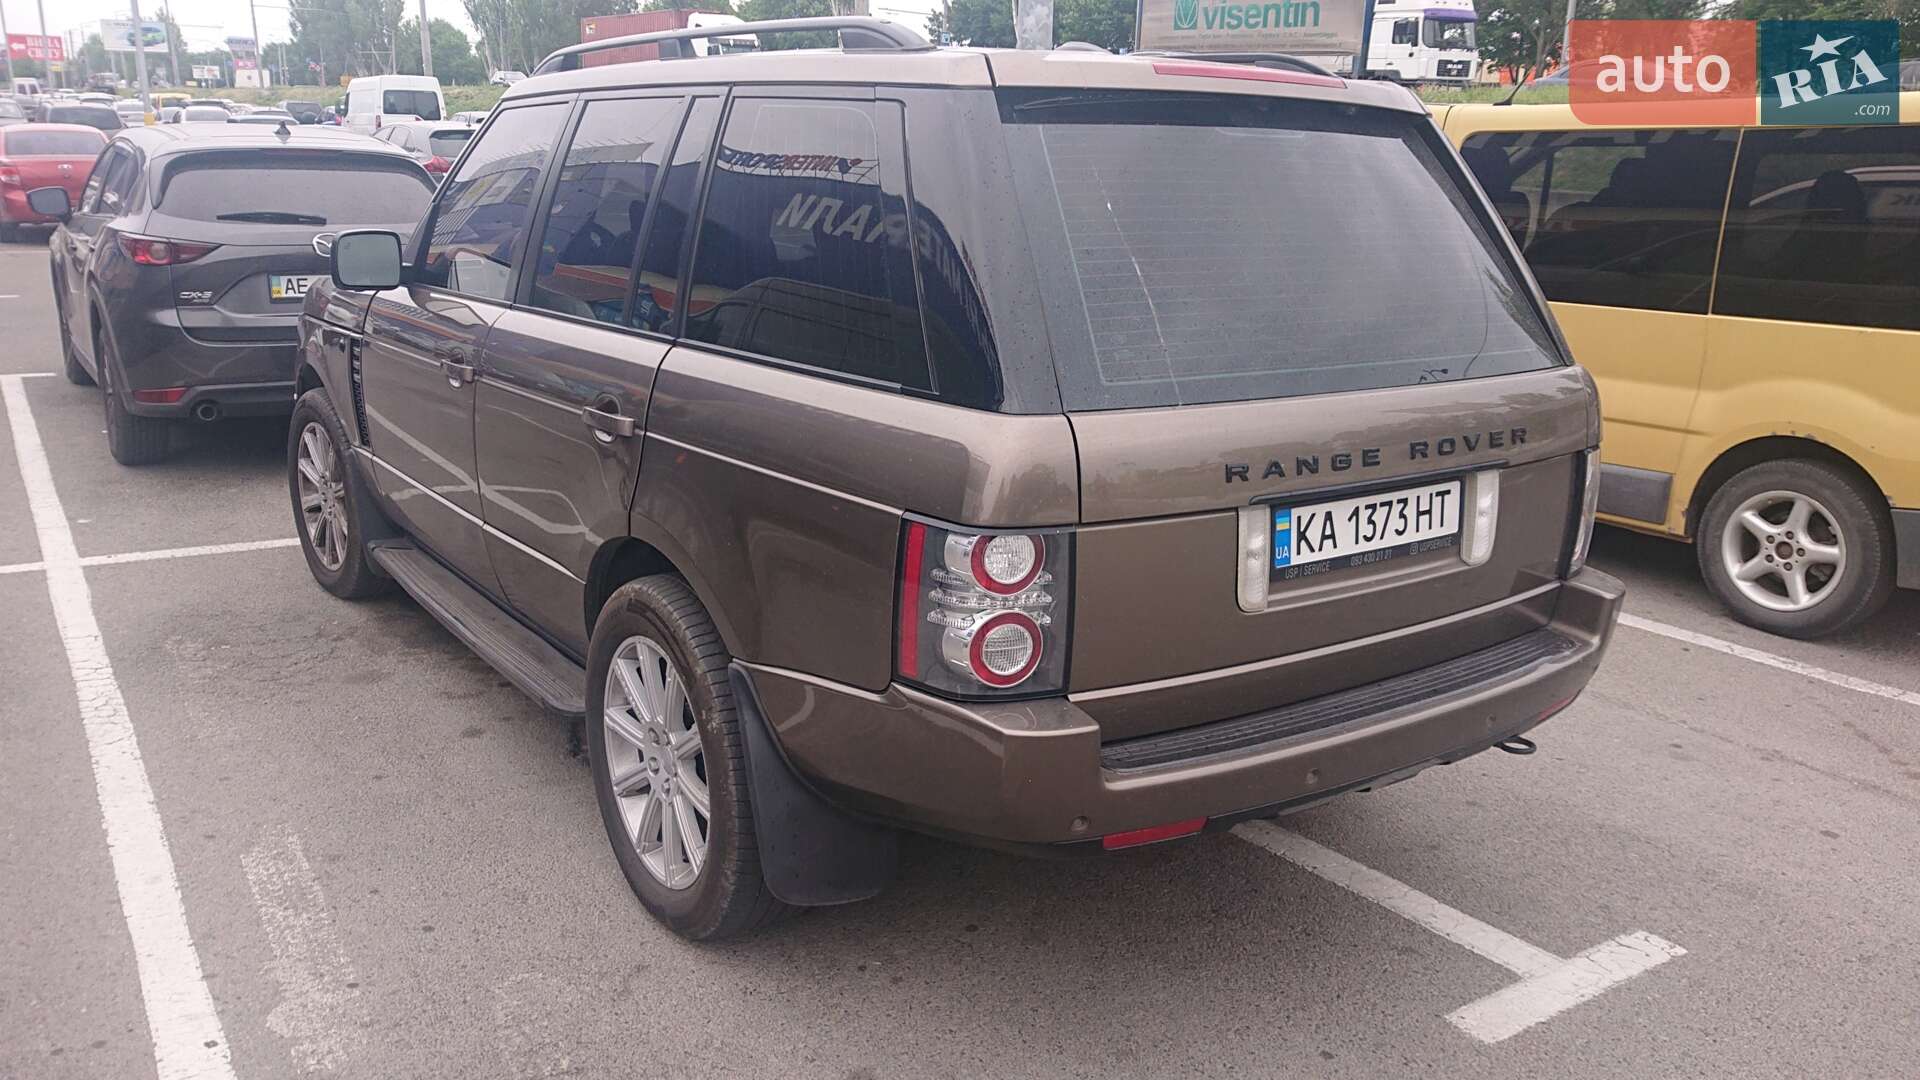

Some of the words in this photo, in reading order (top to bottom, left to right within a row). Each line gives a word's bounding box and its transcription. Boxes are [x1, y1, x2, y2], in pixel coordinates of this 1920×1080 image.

[1202, 0, 1320, 30] visentin
[285, 278, 308, 295] AE
[1225, 448, 1381, 483] RANGE
[1409, 427, 1528, 460] ROVER
[1296, 510, 1338, 556] KA
[1347, 496, 1409, 545] 1373
[1415, 489, 1451, 533] HT
[1275, 546, 1290, 560] UA
